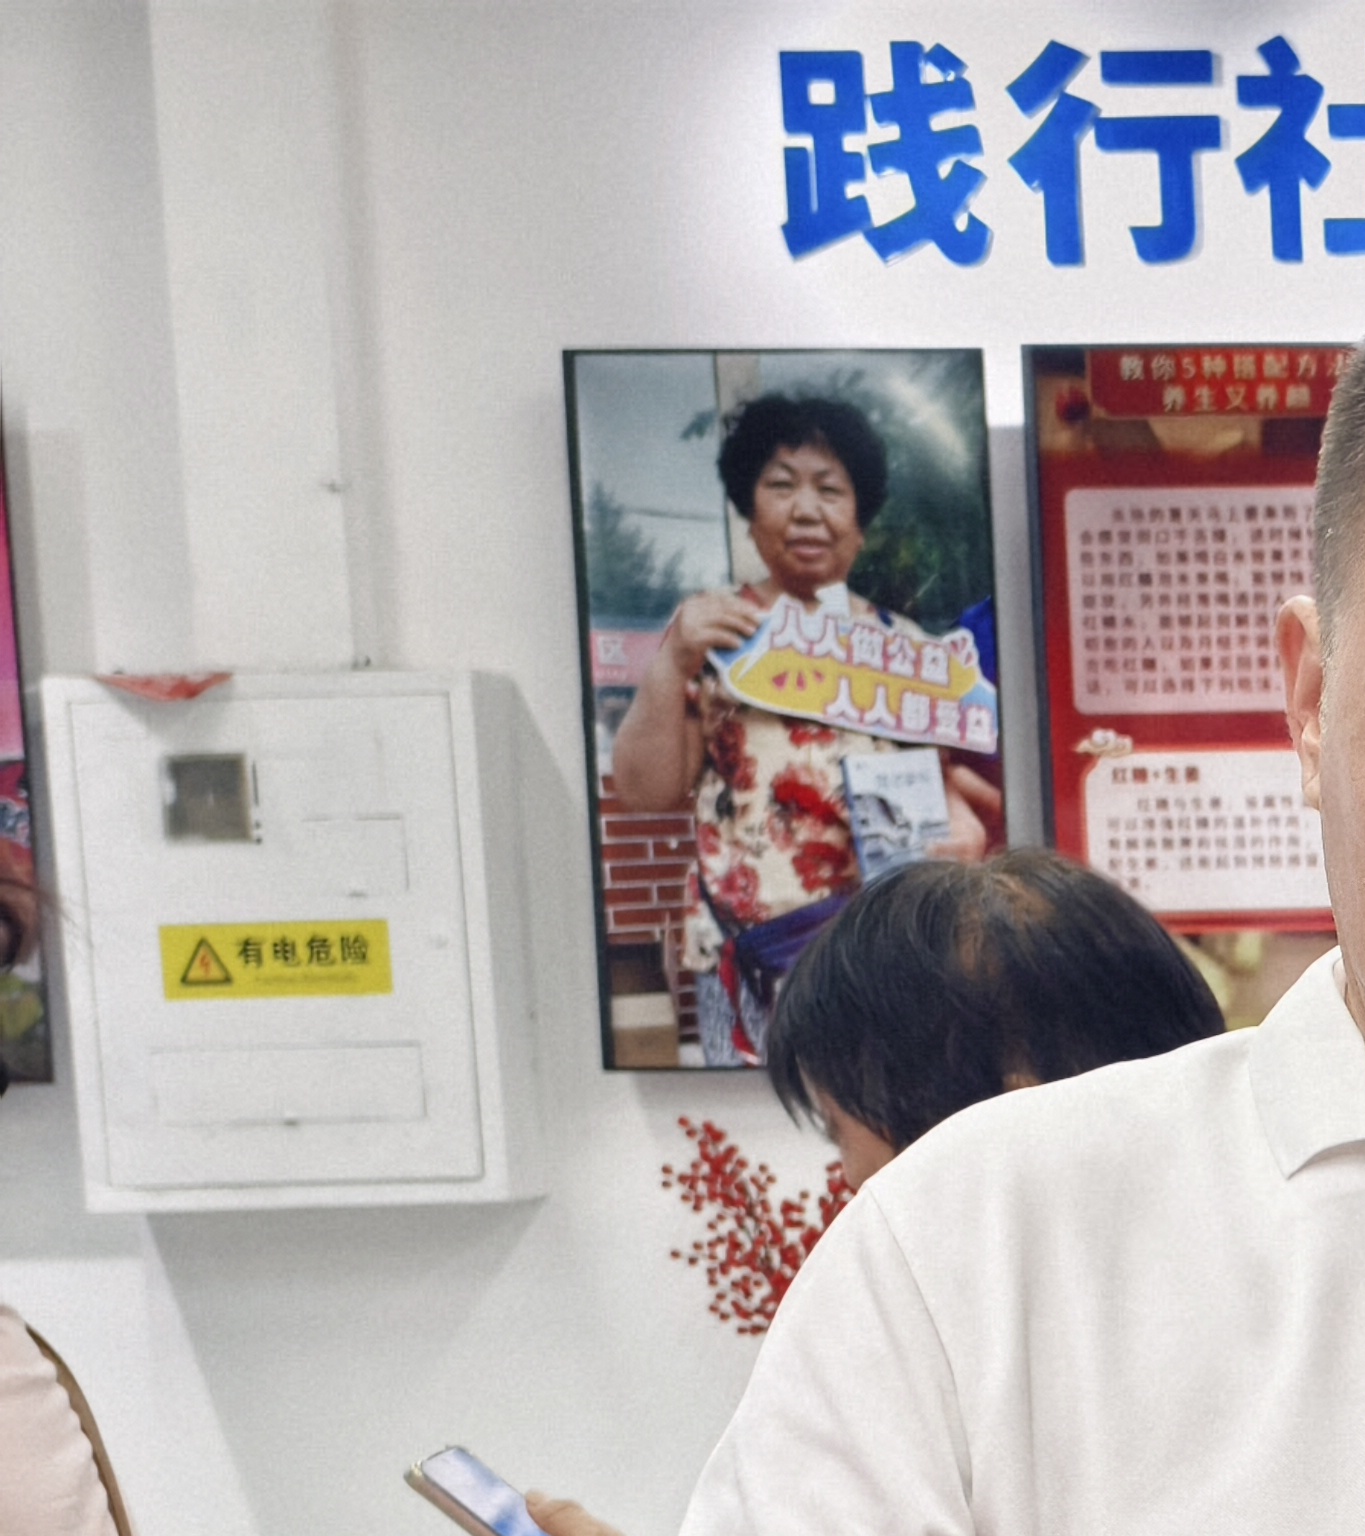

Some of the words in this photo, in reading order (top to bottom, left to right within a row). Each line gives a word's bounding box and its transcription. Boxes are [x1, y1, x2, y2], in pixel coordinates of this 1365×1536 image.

[771, 603, 950, 687] 人人做公益
[238, 934, 370, 969] 有电危险
